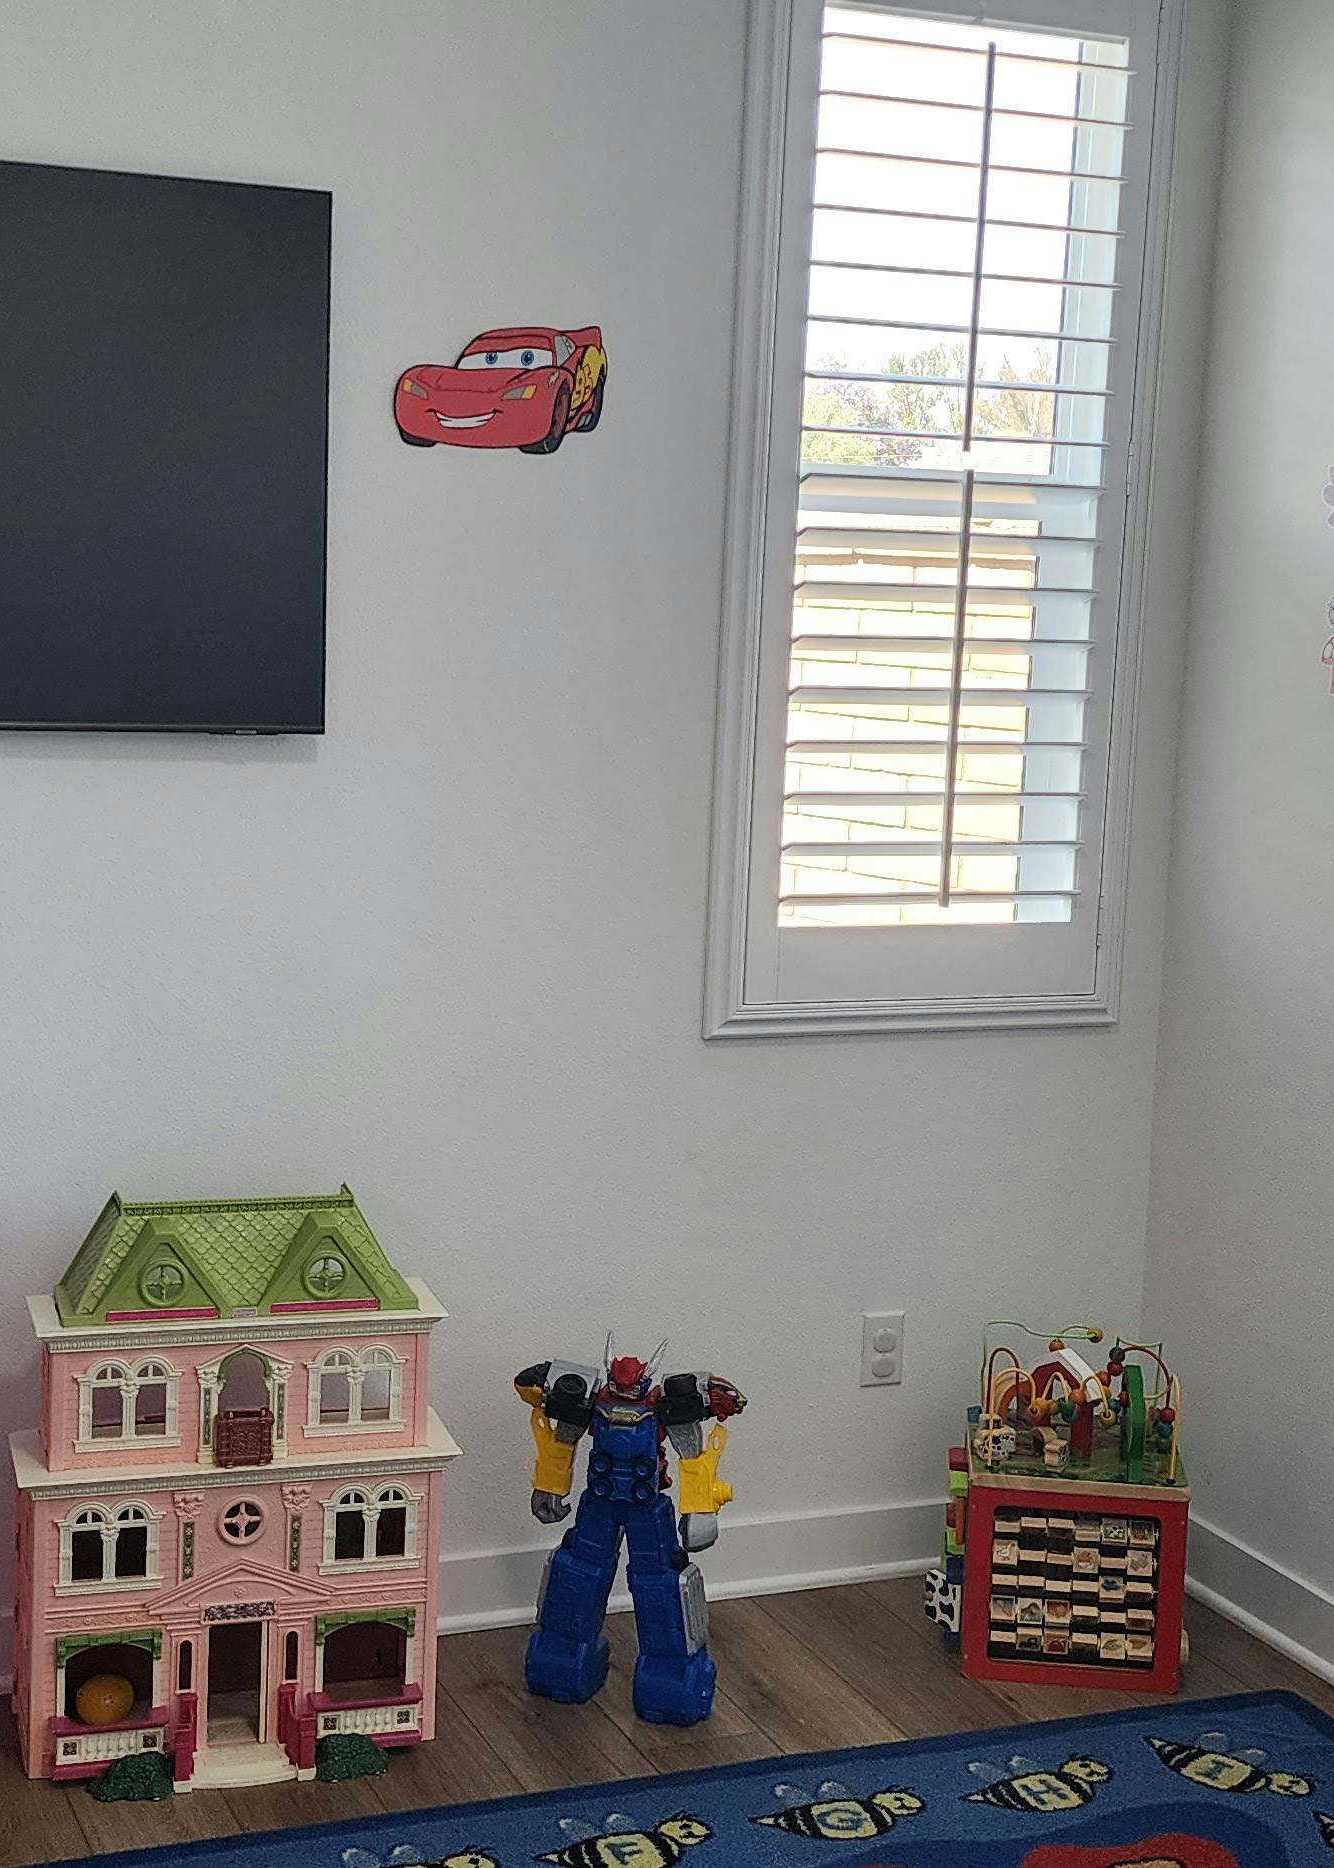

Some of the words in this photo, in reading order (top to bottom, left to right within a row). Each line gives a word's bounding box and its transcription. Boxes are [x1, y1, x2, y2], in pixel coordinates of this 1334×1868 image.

[570, 364, 593, 409] 95
[1019, 1779, 1069, 1805] H
[817, 1809, 868, 1831] G
[605, 1841, 643, 1865] F
